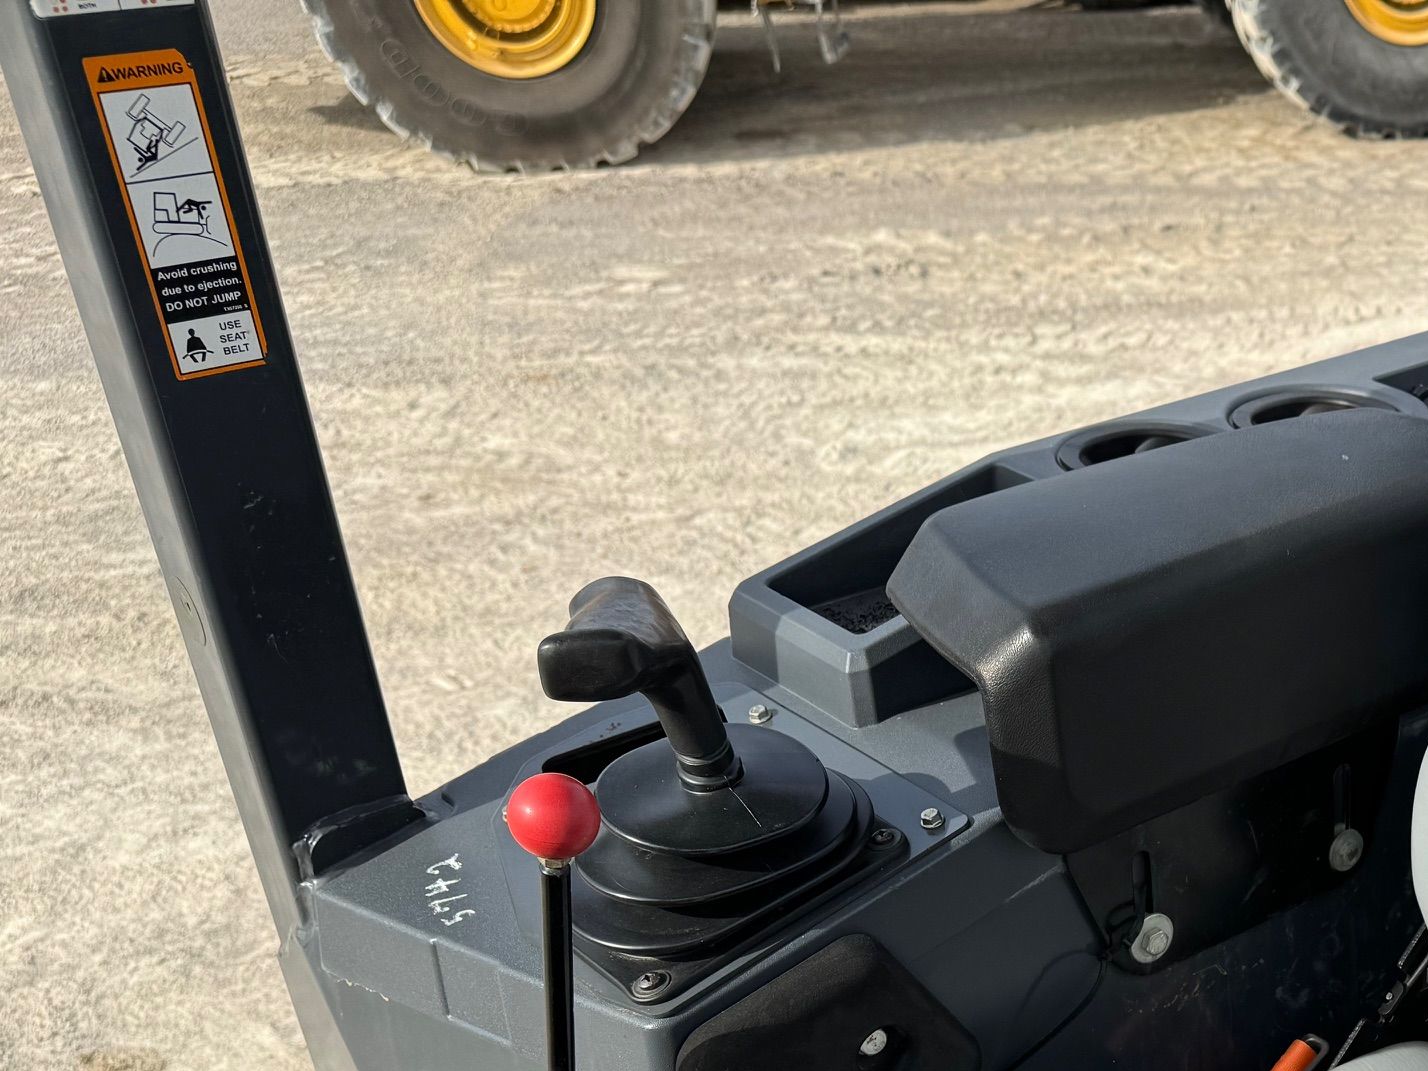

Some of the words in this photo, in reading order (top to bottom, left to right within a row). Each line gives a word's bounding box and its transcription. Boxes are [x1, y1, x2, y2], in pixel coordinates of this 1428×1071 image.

[111, 61, 184, 80] WARNING
[158, 268, 188, 281] Avoid
[190, 261, 237, 276] crushing
[162, 287, 182, 296] due
[184, 284, 195, 293] to
[197, 277, 242, 292] ejection.
[166, 301, 183, 312] DO
[185, 296, 208, 309] NOT
[212, 291, 241, 304] JUMP
[219, 320, 241, 331] USE
[220, 331, 247, 343] SEAT
[223, 343, 250, 355] BELT
